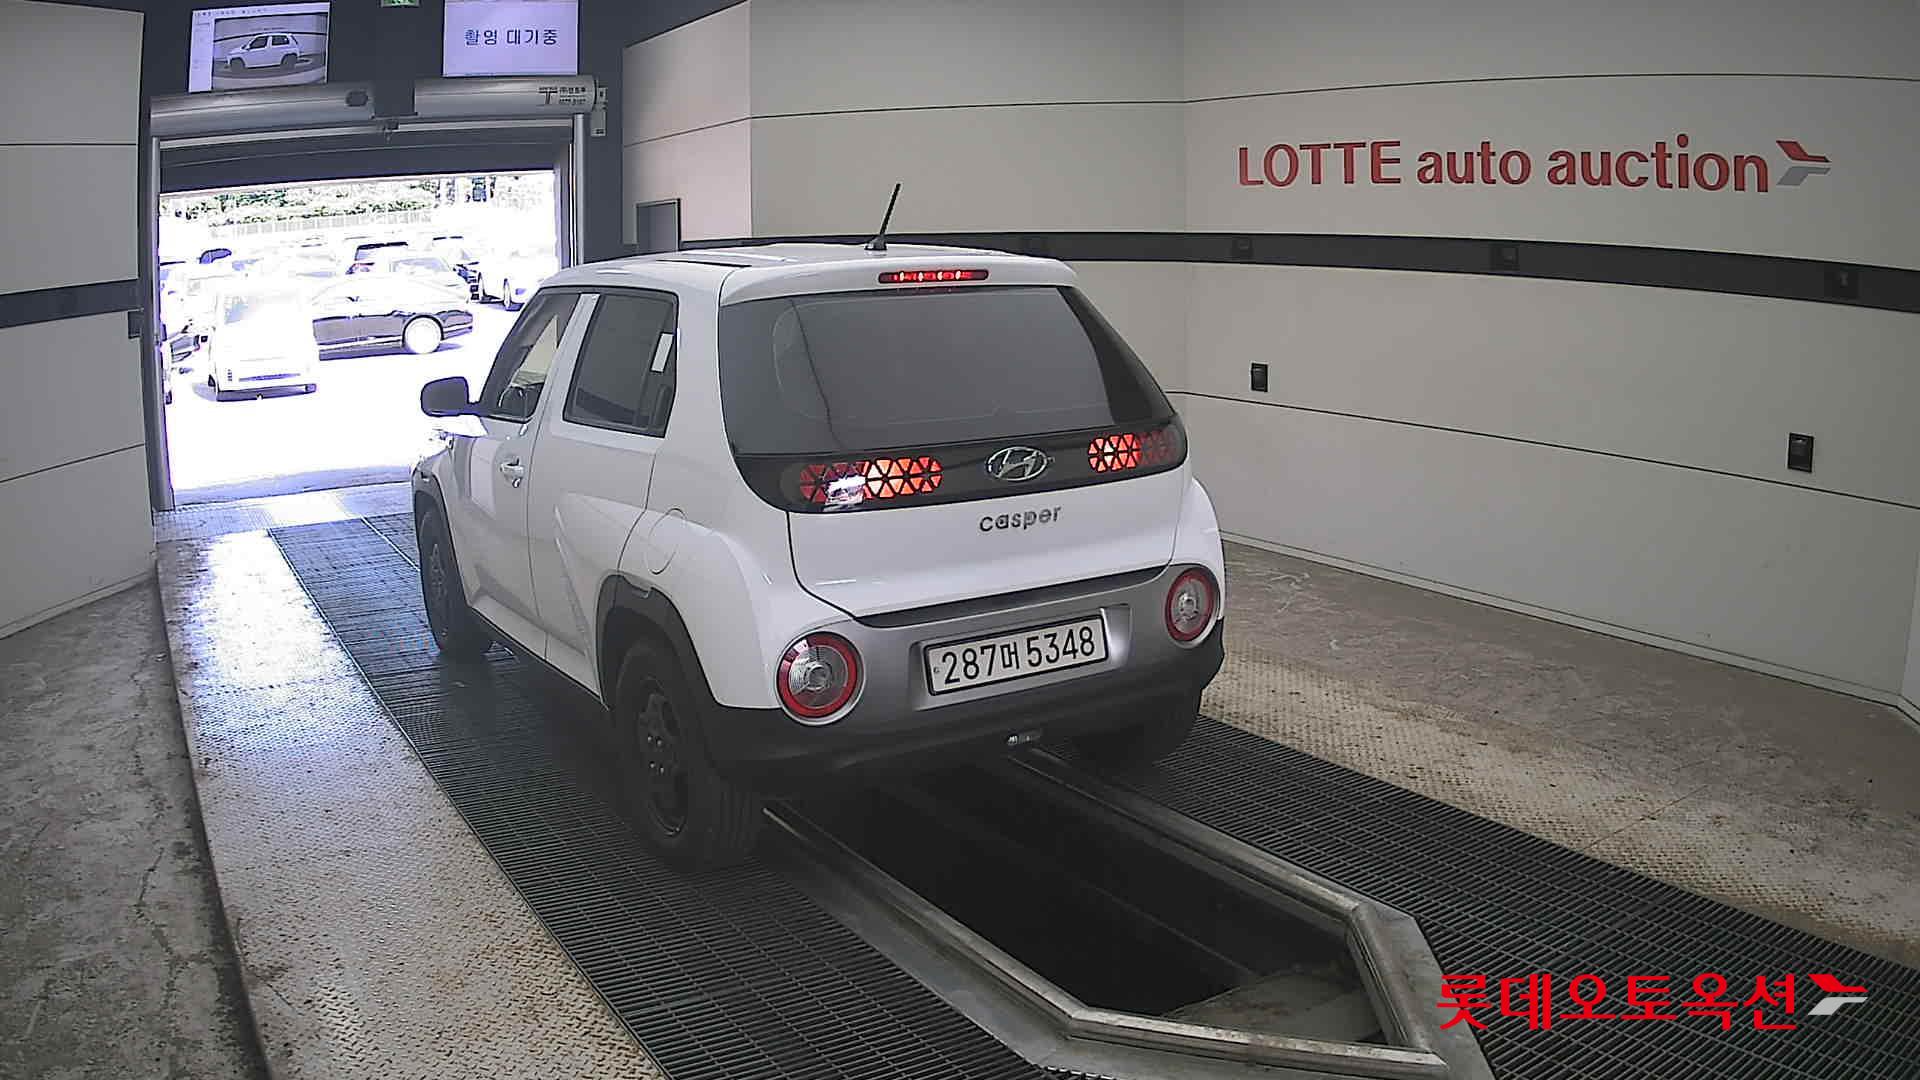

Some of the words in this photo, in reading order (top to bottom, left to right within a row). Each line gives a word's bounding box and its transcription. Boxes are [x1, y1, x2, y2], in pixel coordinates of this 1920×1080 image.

[506, 29, 558, 46] 대기중
[1239, 140, 1401, 187] LOTTE
[1416, 141, 1532, 185] auto
[1547, 133, 1769, 193] auction
[979, 506, 1062, 532] casper
[941, 641, 1020, 685] 287머
[1026, 626, 1095, 668] 5348
